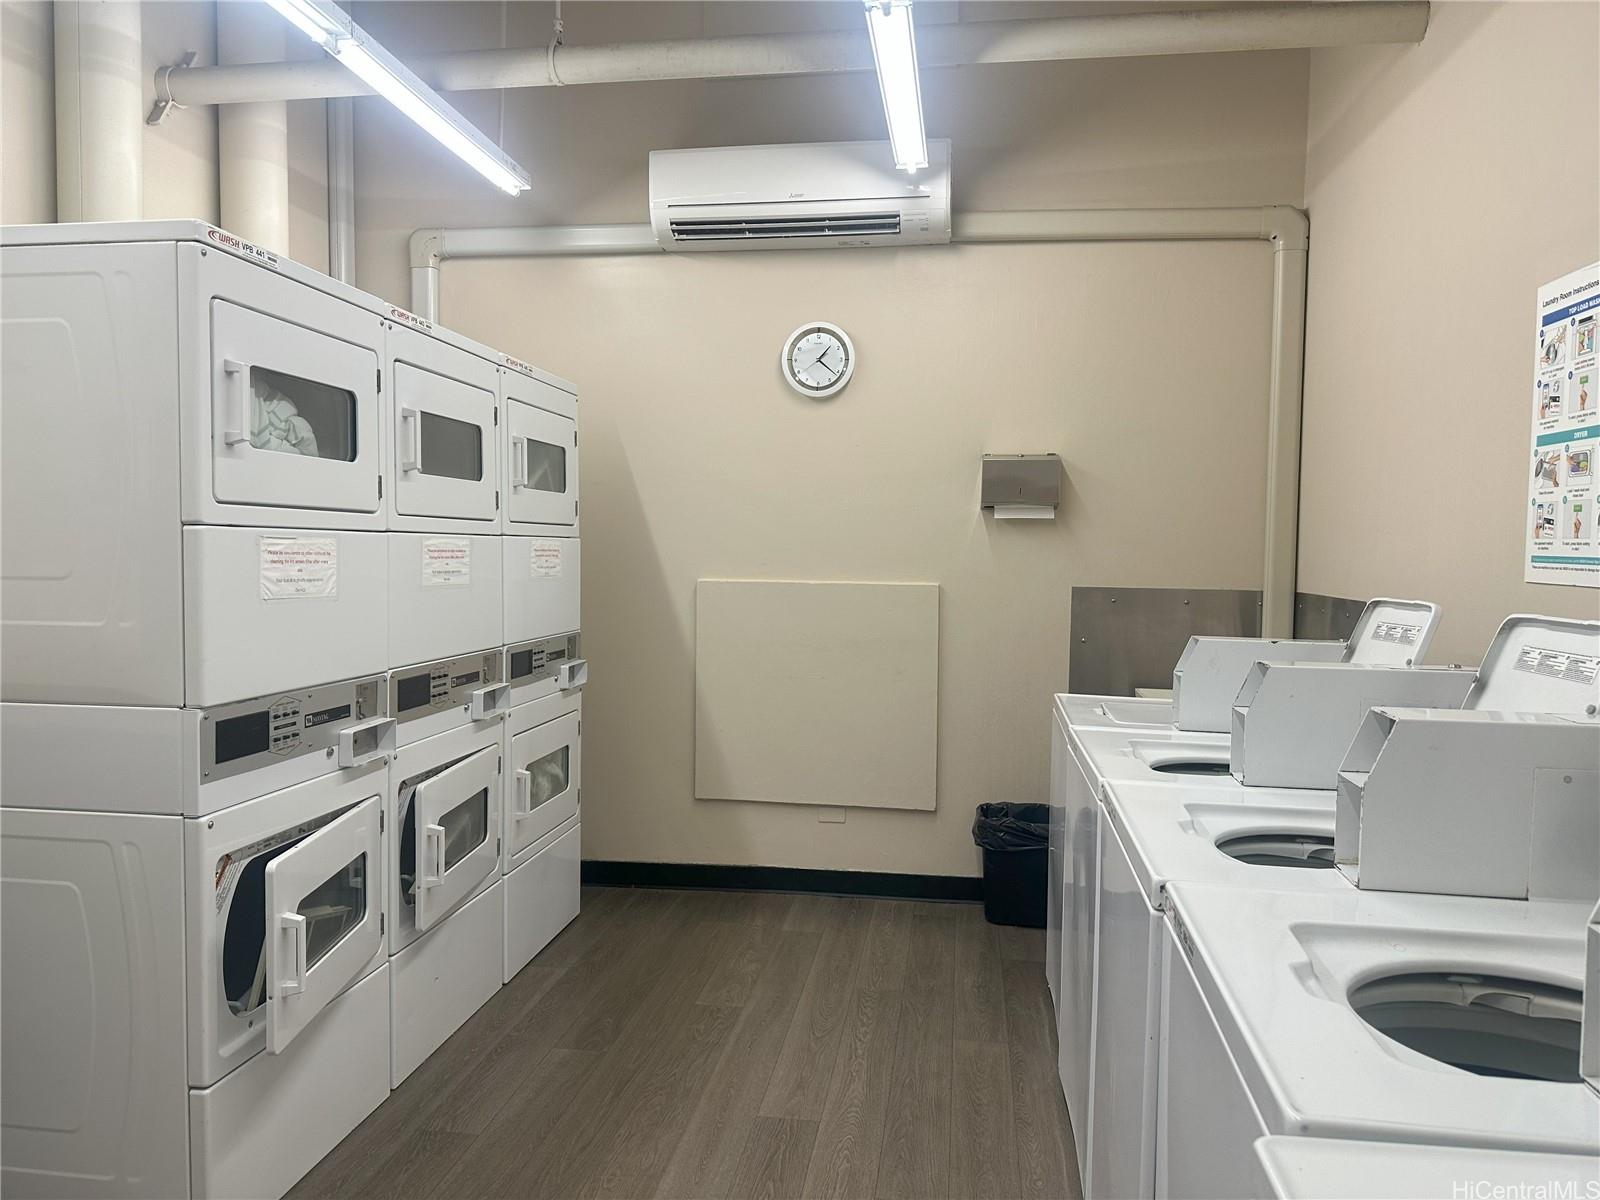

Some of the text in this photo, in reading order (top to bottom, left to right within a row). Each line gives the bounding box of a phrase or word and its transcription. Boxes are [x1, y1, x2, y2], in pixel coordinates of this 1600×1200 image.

[218, 232, 265, 259] WASH VPB 441
[1542, 279, 1600, 308] Laundry Room Instructions
[1569, 307, 1577, 315] TOP
[1577, 301, 1588, 312] LOAD
[1573, 430, 1588, 439] DRYER
